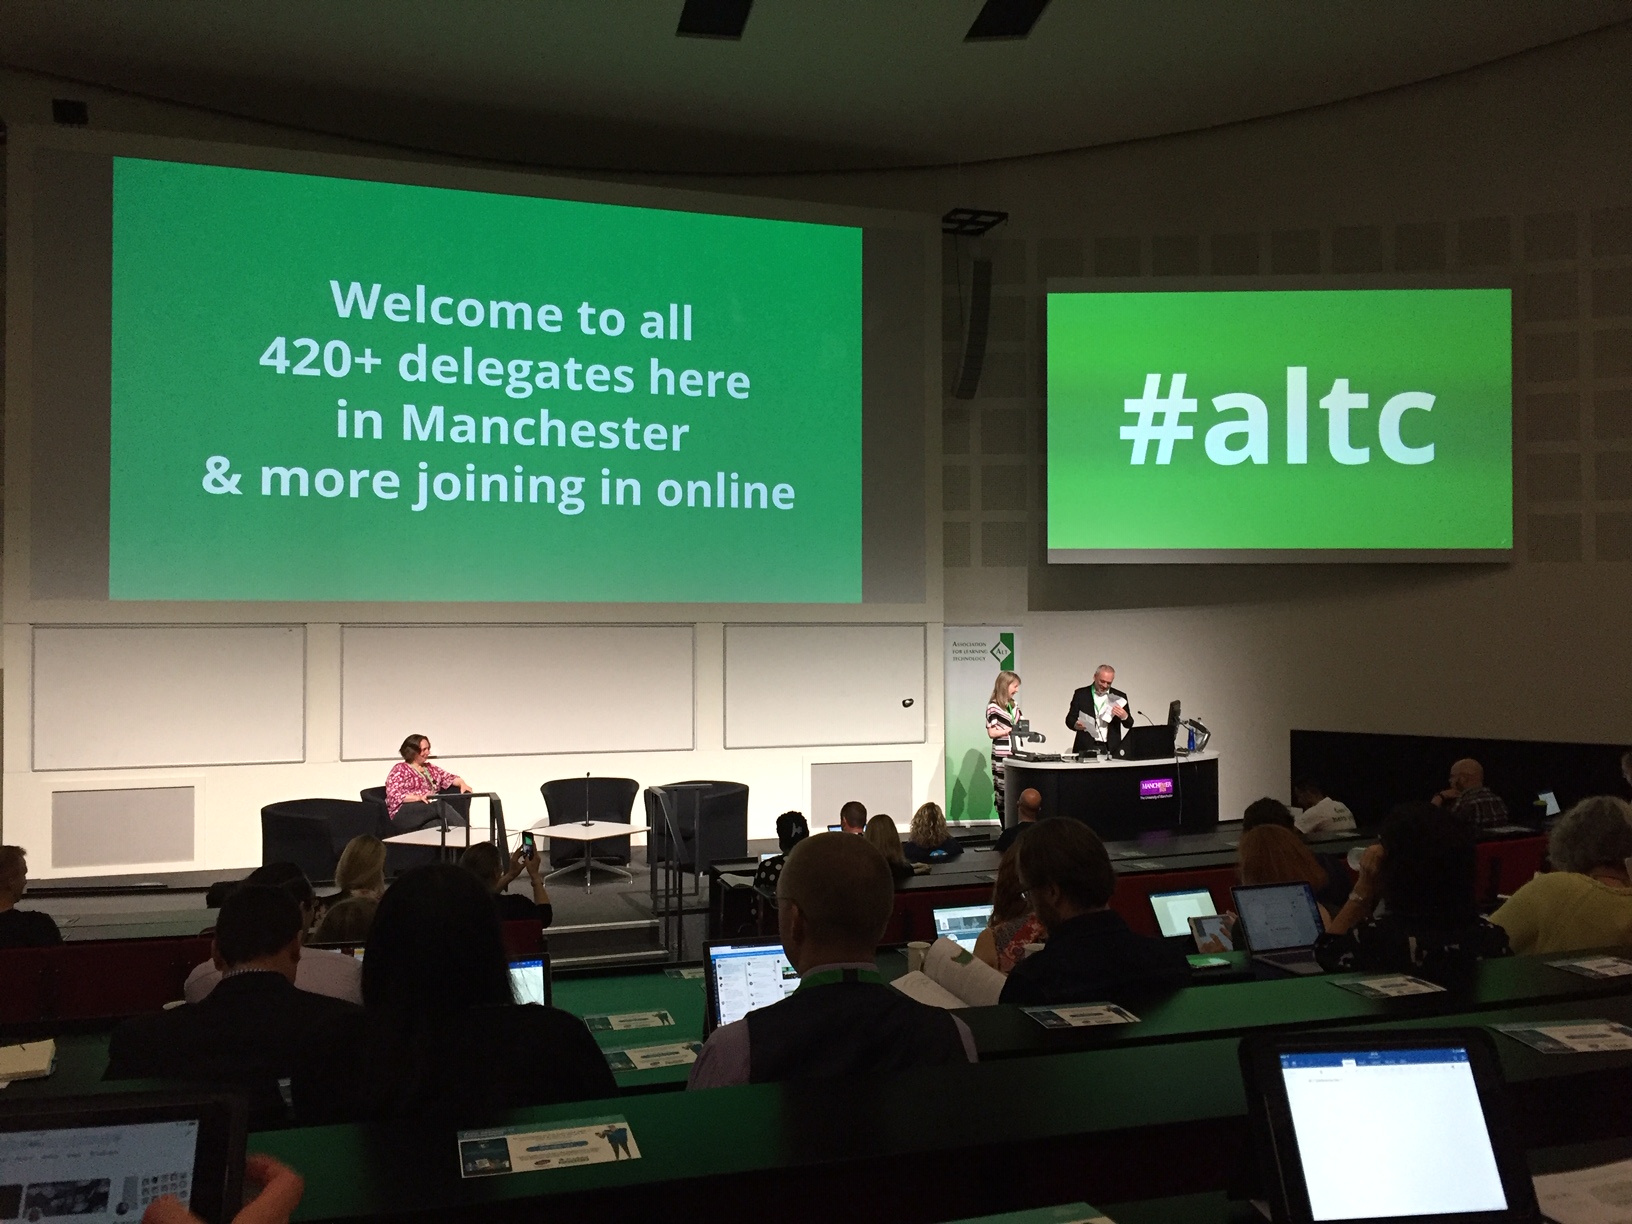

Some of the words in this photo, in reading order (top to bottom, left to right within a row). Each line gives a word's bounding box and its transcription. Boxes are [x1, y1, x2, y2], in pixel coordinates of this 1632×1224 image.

[329, 280, 563, 333] Welcome
[577, 301, 625, 336] to
[640, 303, 692, 341] all
[259, 336, 382, 378] 420+
[398, 343, 634, 399] delegates
[650, 357, 750, 399] here
[337, 398, 382, 440] in
[403, 404, 690, 451] Manchester
[1119, 366, 1437, 466] #altc
[202, 455, 243, 495] &
[261, 466, 400, 500] more
[411, 461, 586, 515] joining
[601, 467, 641, 506] in
[657, 471, 795, 510] online
